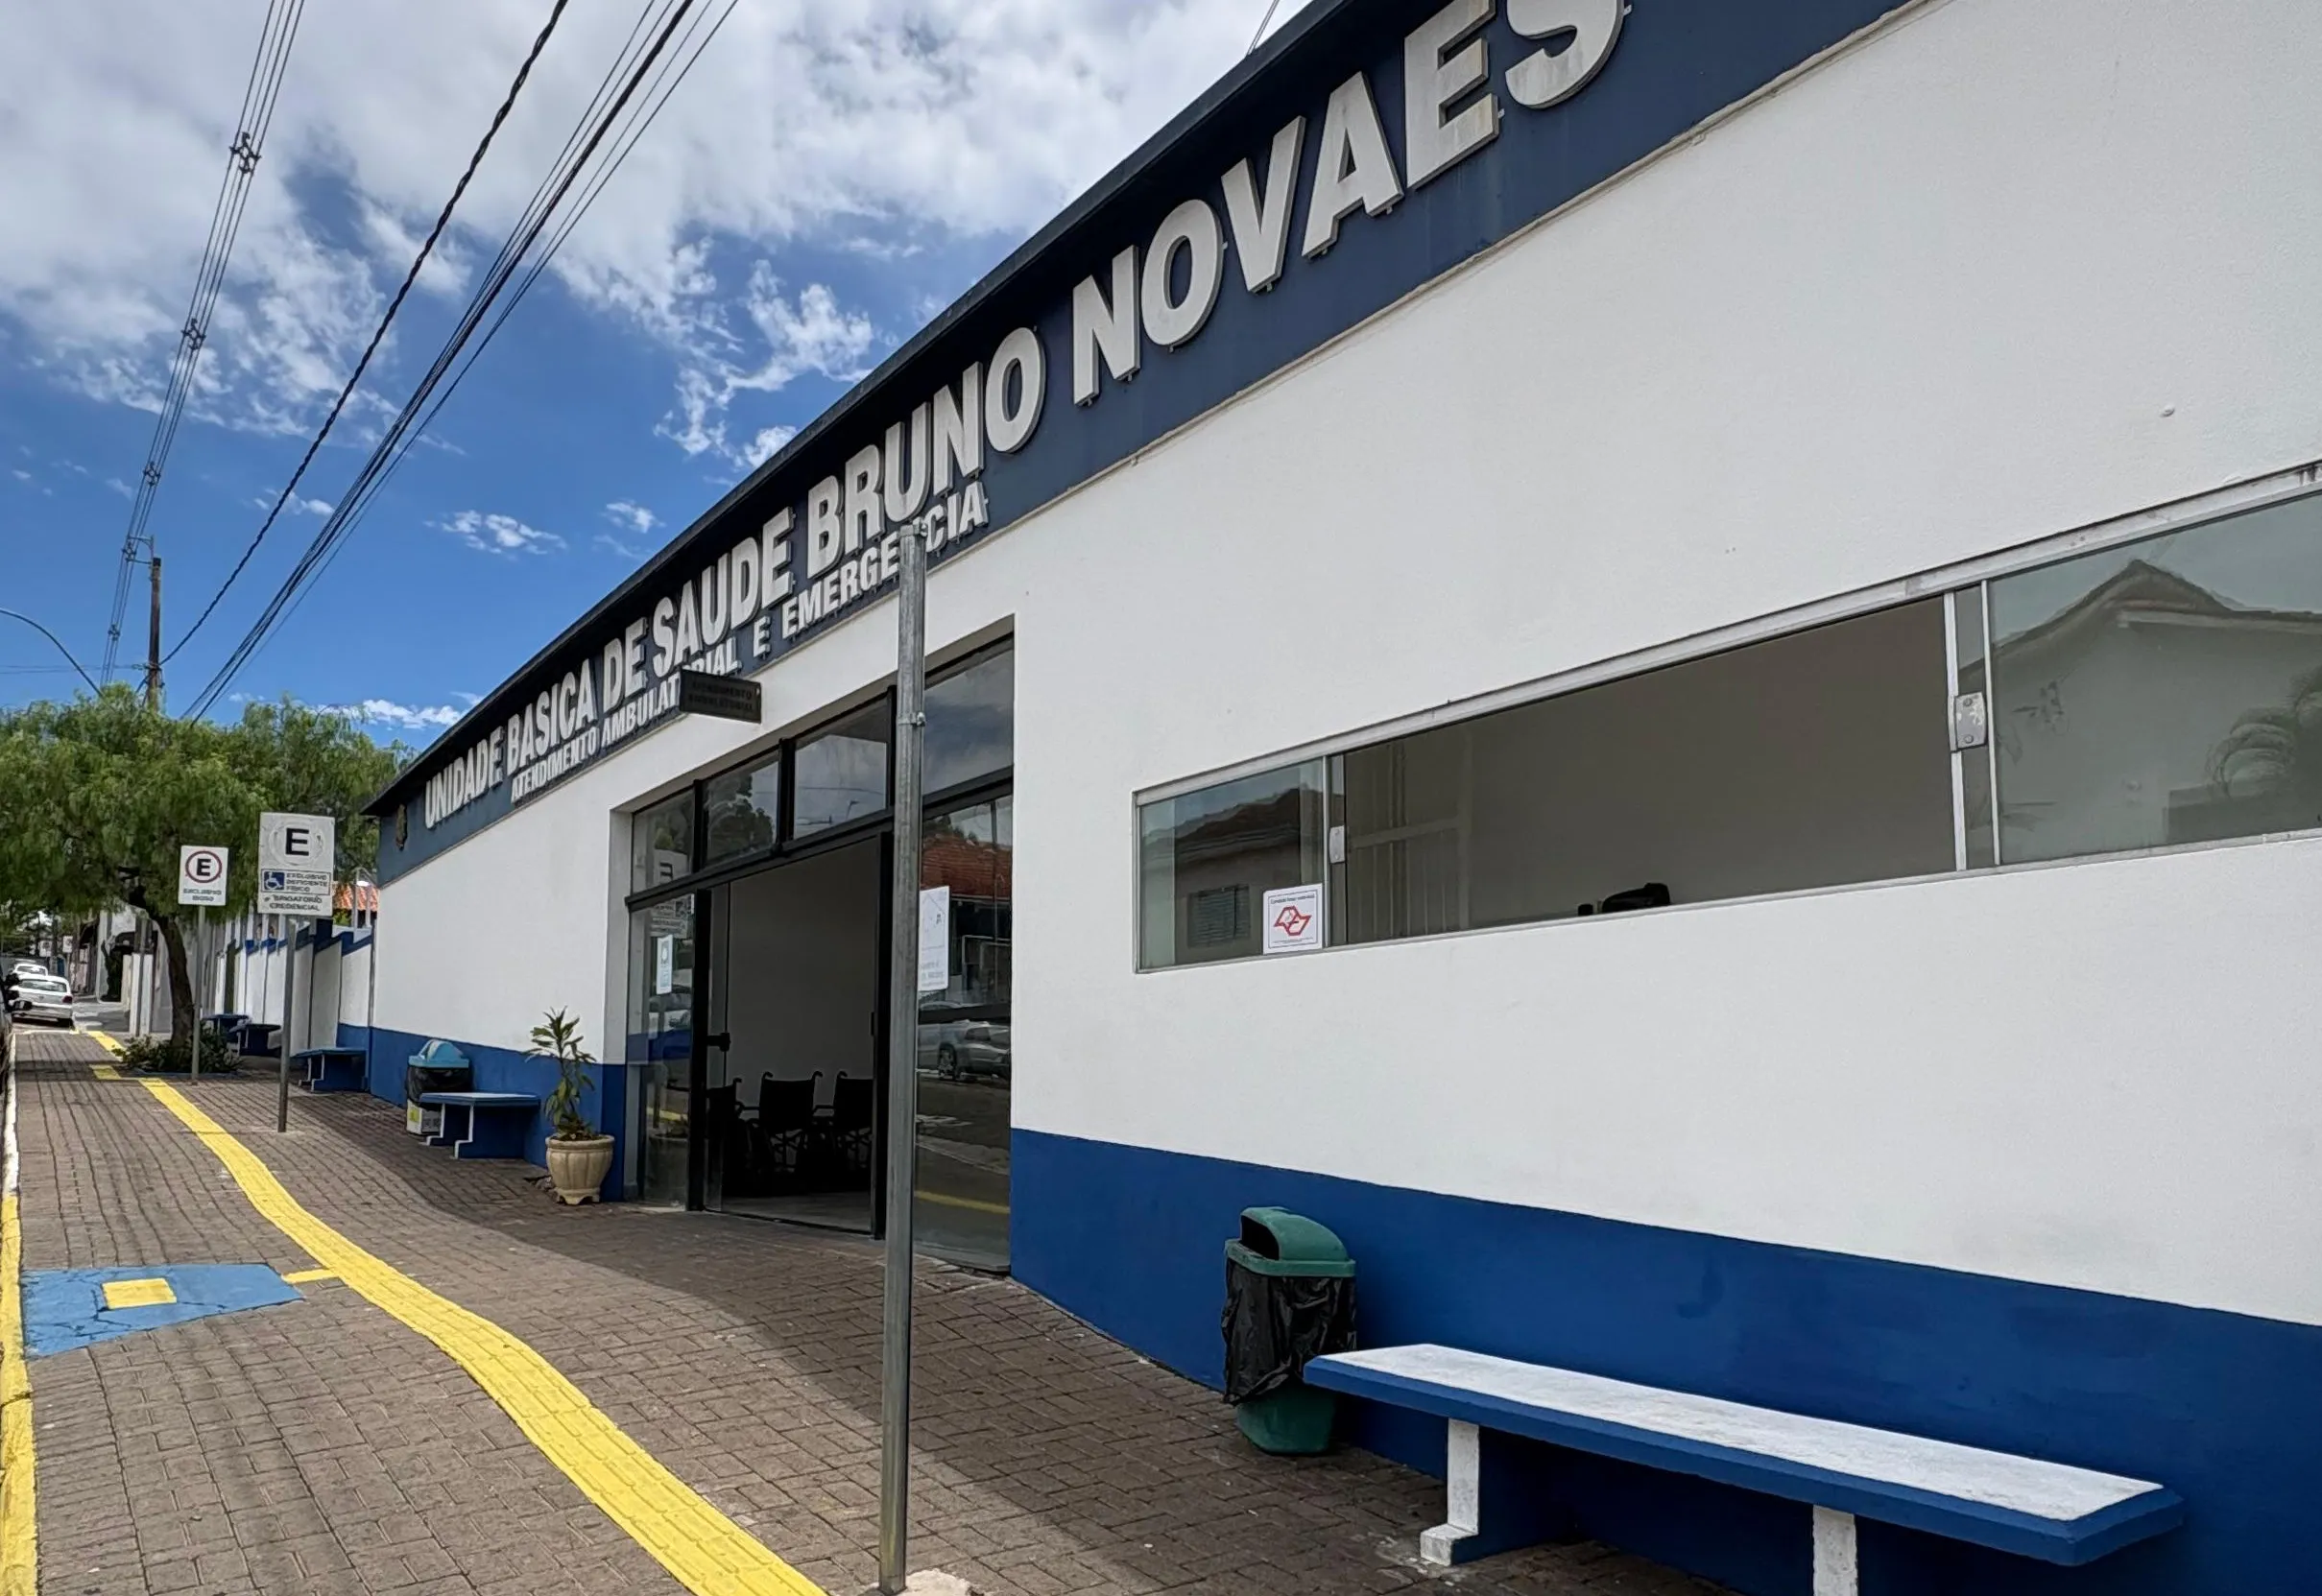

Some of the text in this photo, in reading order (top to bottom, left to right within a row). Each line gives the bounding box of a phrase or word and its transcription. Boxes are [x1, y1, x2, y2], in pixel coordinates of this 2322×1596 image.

[425, 0, 1626, 829] UNIDADE BASICA DE SAUDE BRUNO NOVAES
[511, 481, 989, 804] ATENDIMENTO AMBULATIAL E EMERGECIA
[196, 858, 212, 876] E
[286, 827, 310, 856] E
